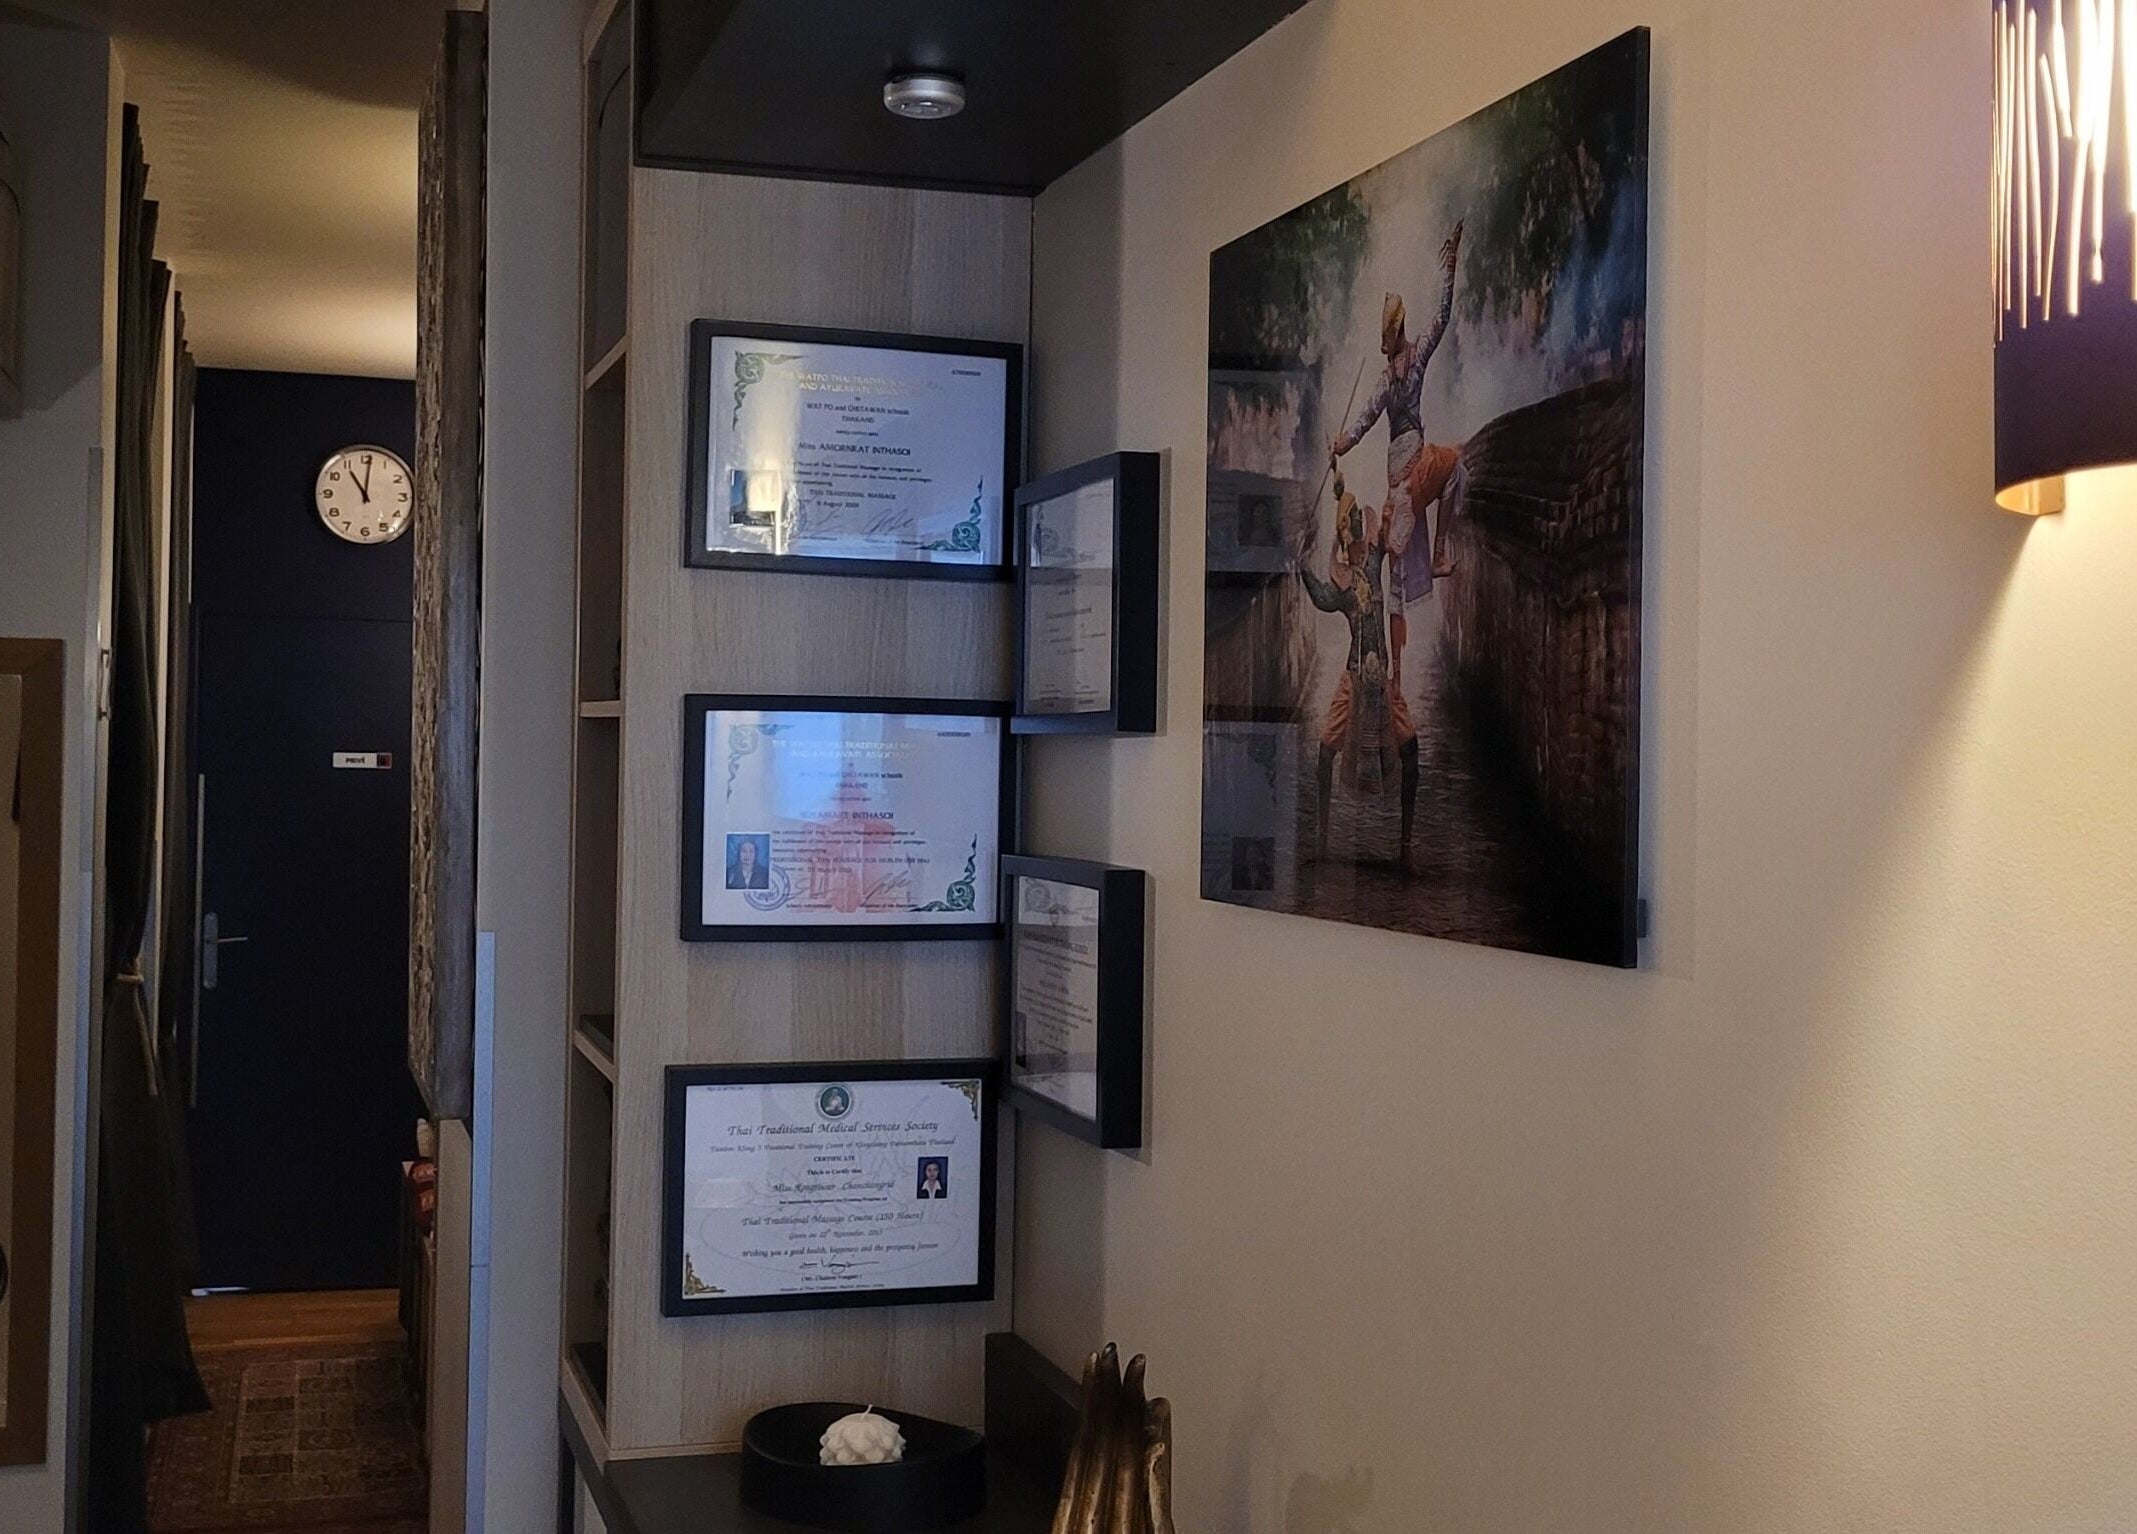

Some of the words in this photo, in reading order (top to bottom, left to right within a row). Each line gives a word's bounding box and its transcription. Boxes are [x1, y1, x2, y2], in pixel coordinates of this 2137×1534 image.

[343, 459, 352, 470] 11
[360, 455, 373, 465] 12
[383, 460, 387, 470] 1
[329, 471, 340, 481] 10
[393, 475, 403, 484] 2
[323, 489, 333, 498] 9
[398, 492, 408, 502] 3
[329, 507, 340, 517] 8
[392, 510, 401, 518] 4
[342, 521, 352, 531] 7
[379, 523, 389, 532] 5
[360, 527, 370, 537] 6
[727, 1125, 752, 1136] Thai
[757, 1122, 816, 1135] Traditional
[818, 1121, 860, 1133] Medical
[861, 1121, 901, 1132] Services
[903, 1120, 939, 1133] Society
[813, 1155, 856, 1163] CERTIFICATE
[742, 1216, 762, 1226] Thai
[763, 1215, 810, 1225] Traditional
[811, 1214, 845, 1225] Massage
